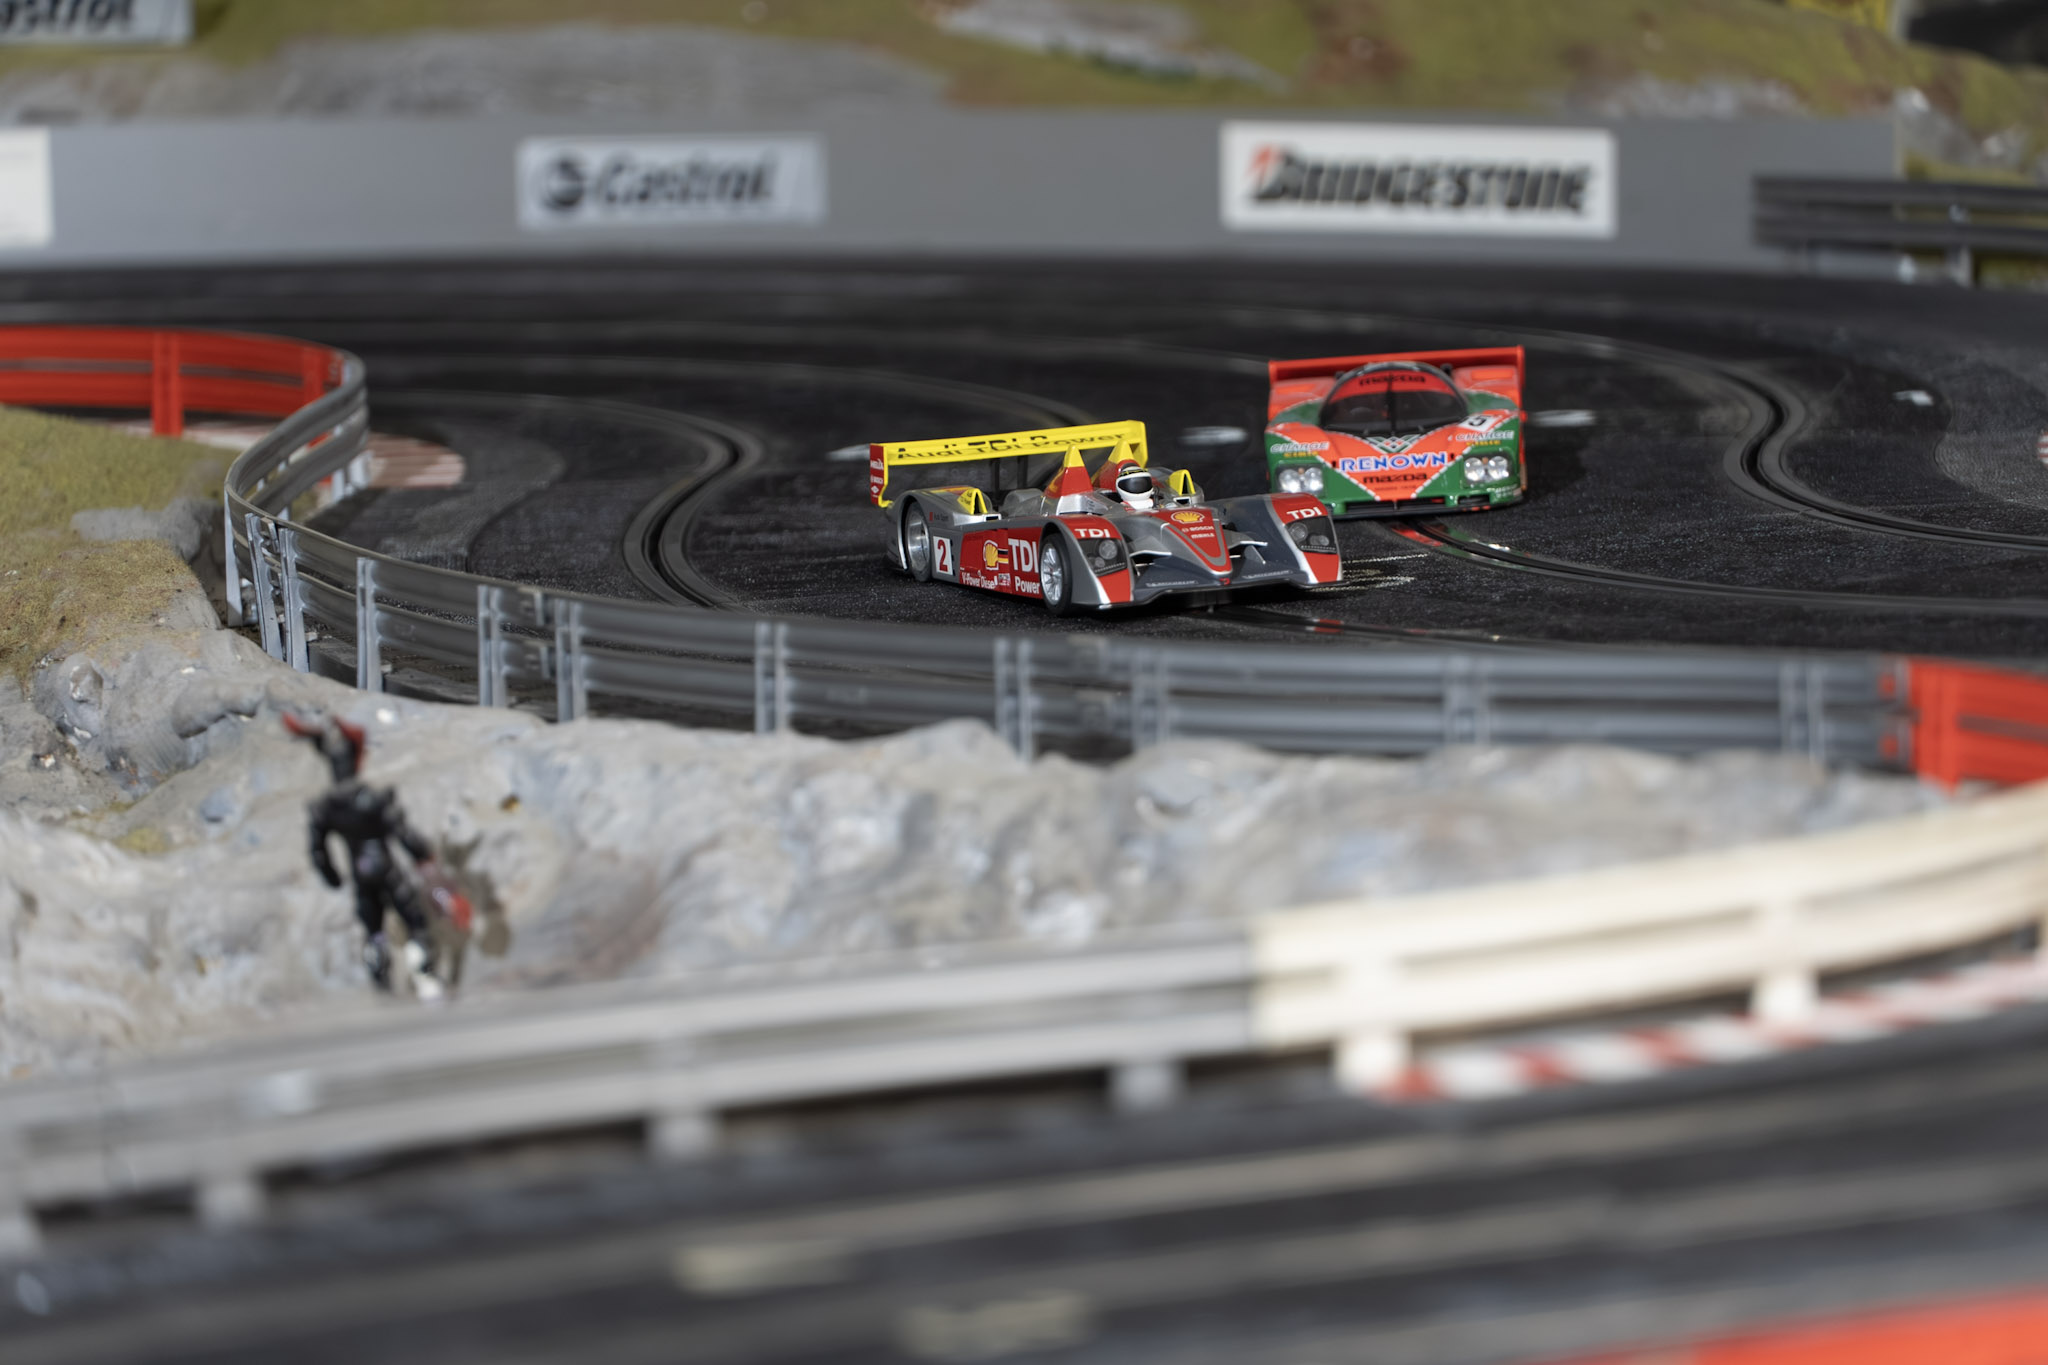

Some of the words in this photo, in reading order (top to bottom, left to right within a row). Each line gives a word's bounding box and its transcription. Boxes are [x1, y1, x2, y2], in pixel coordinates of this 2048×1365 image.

[599, 153, 776, 206] Castrol
[1468, 415, 1488, 427] 5
[1340, 452, 1447, 472] RENOWN
[1286, 507, 1322, 519] TDI
[1075, 529, 1110, 538] TDI
[937, 539, 949, 572] 2
[1008, 538, 1039, 573] TDI
[1014, 576, 1040, 594] Power
